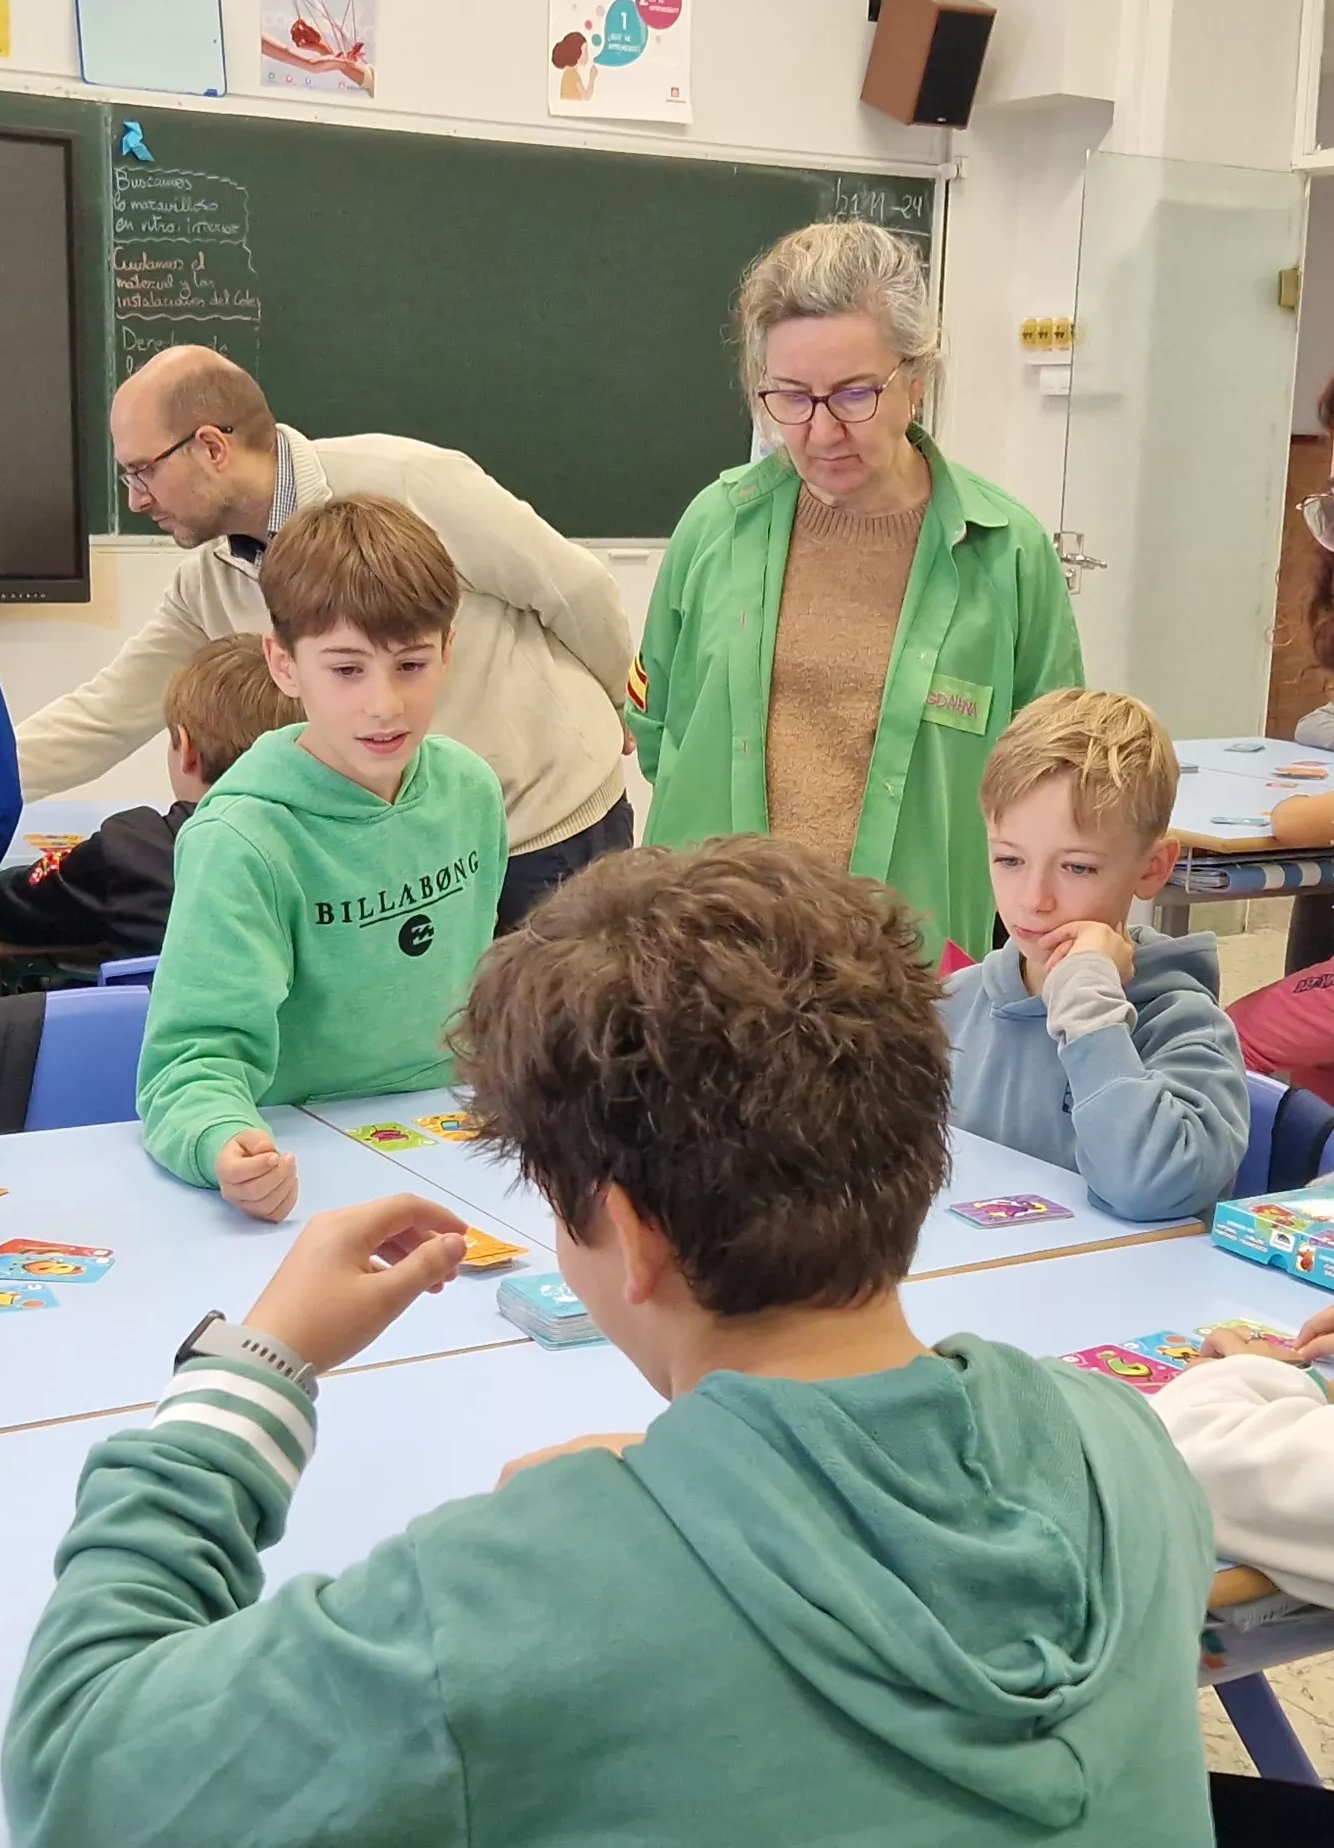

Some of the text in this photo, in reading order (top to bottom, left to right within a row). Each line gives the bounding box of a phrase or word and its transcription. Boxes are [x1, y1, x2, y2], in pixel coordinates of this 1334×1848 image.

[620, 11, 627, 30] 1
[115, 169, 192, 191] Buscamos
[131, 197, 218, 212] maravilloso
[116, 217, 134, 233] en
[191, 251, 205, 270] el
[116, 274, 174, 289] material
[179, 280, 191, 300] y
[210, 290, 230, 306] del
